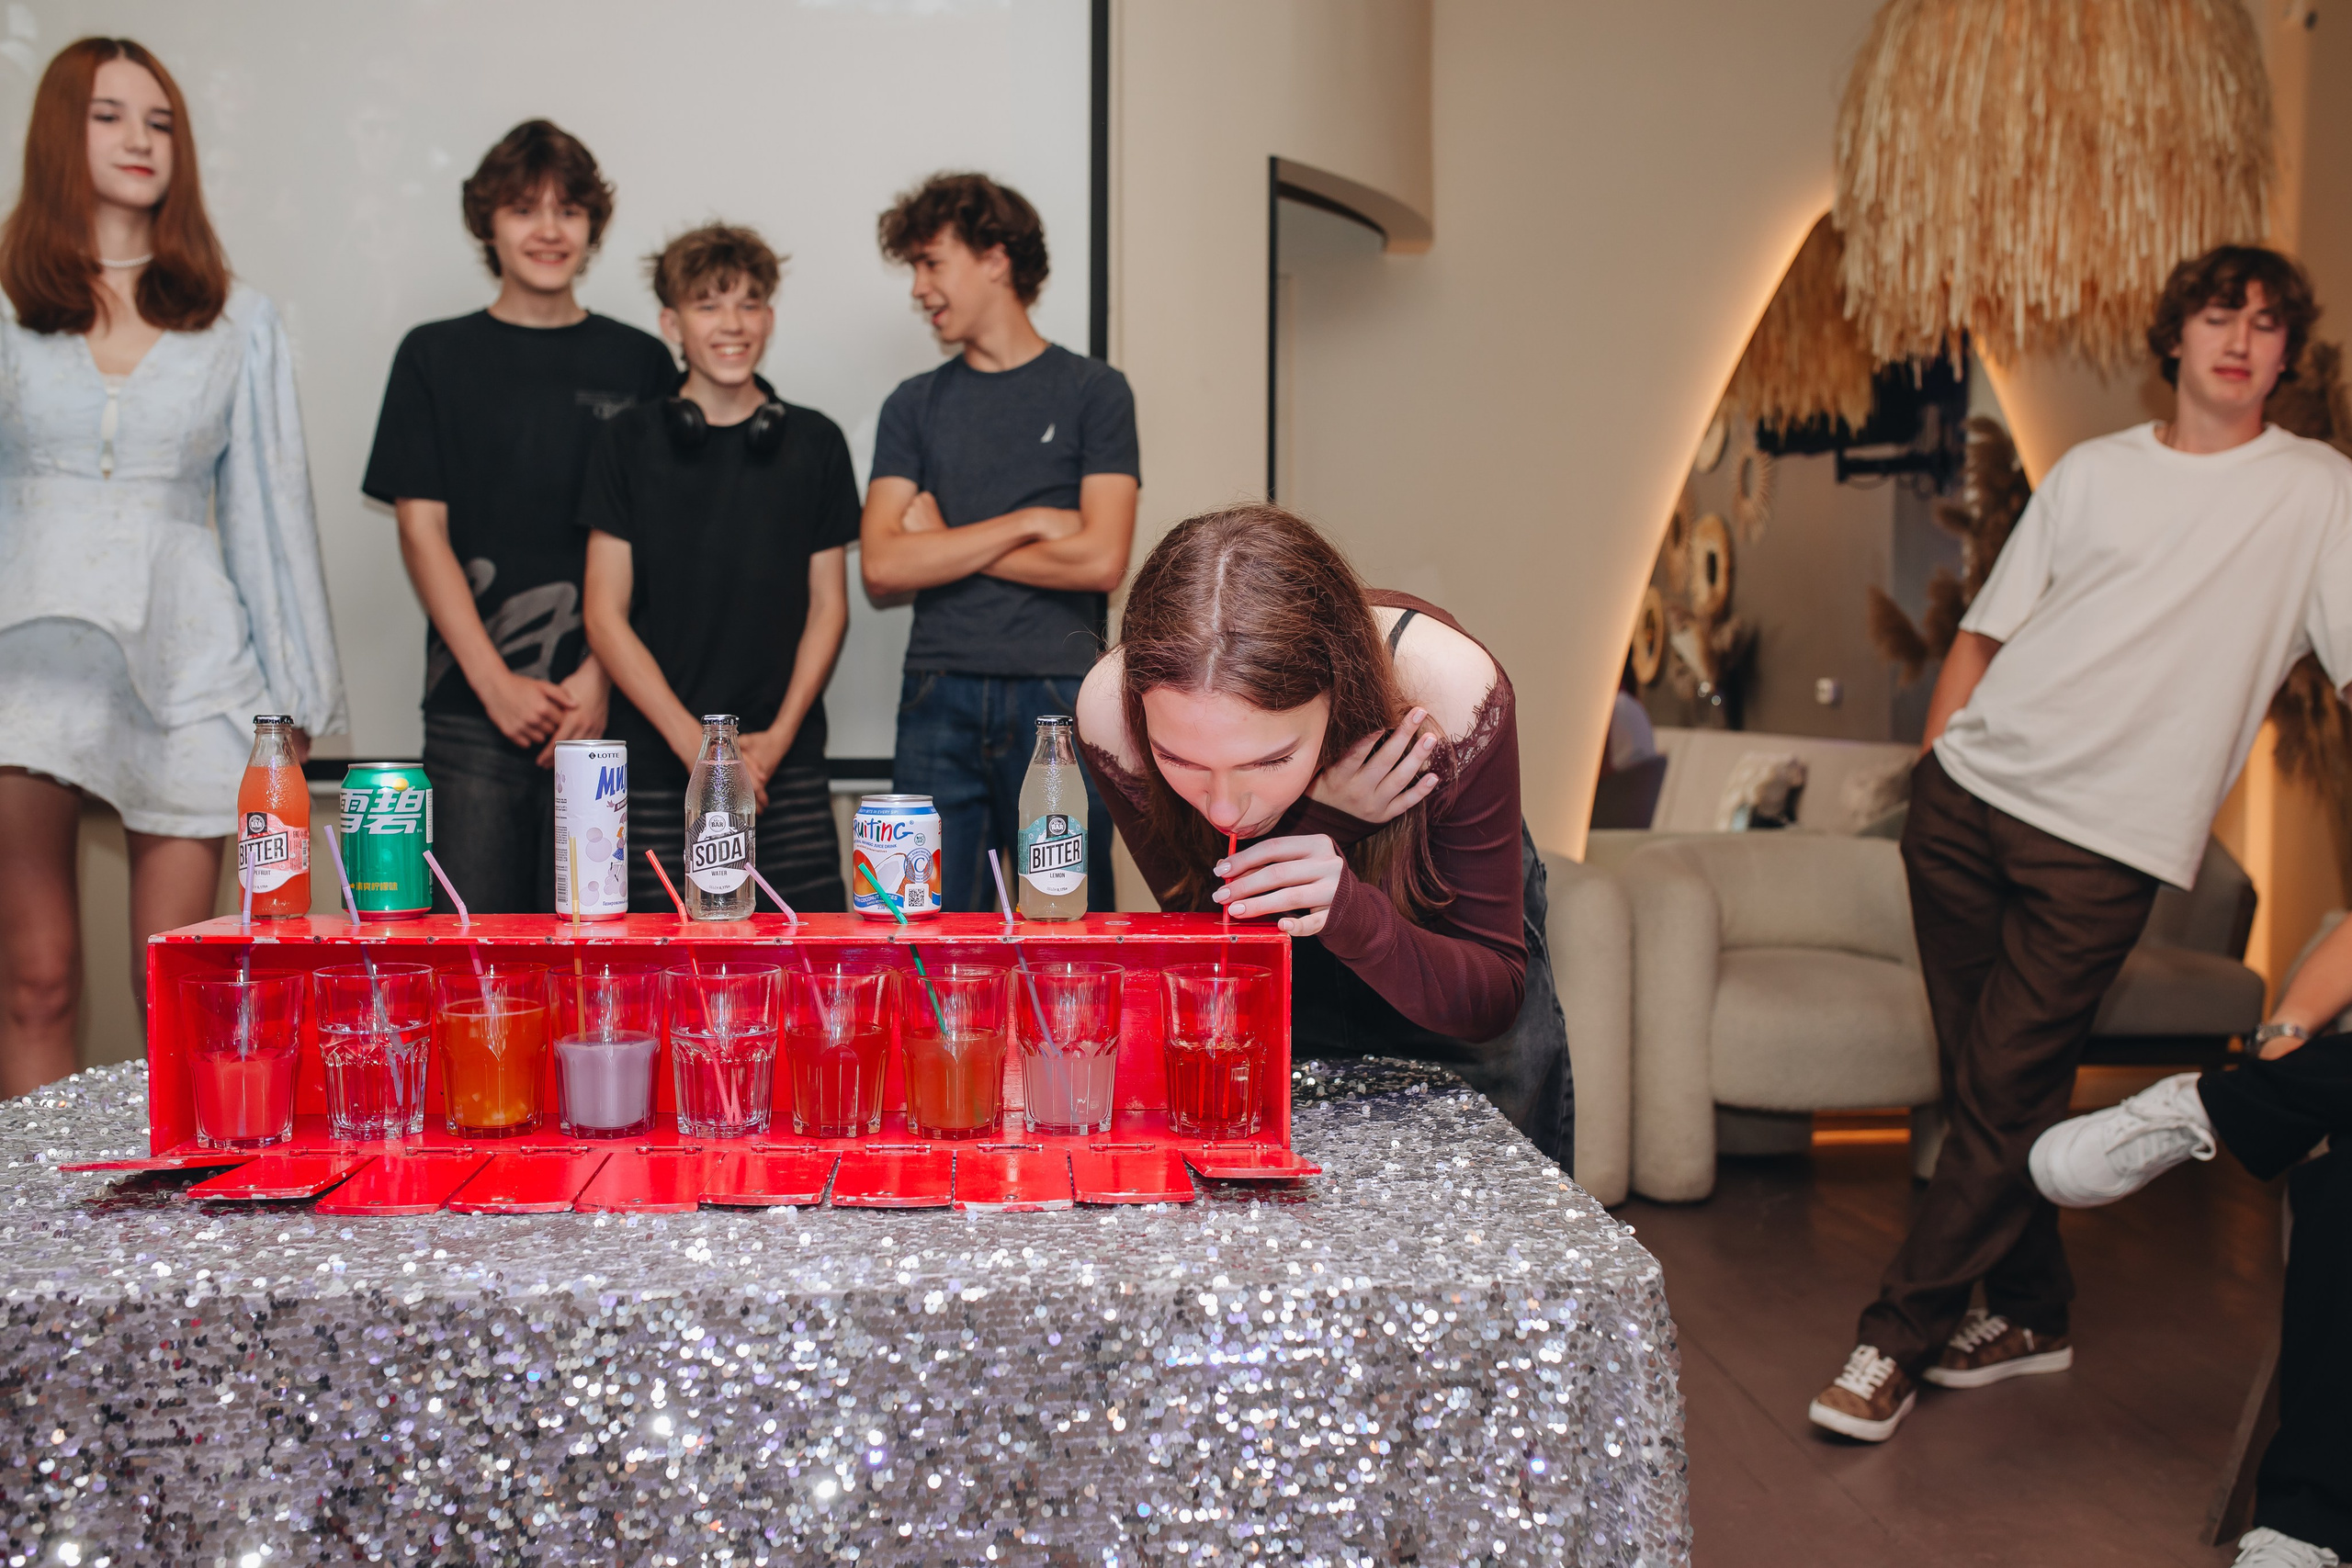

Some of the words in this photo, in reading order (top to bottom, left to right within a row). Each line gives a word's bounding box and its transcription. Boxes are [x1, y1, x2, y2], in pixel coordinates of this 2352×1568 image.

[340, 787, 424, 834] 雪碧
[695, 837, 742, 867] SODA
[914, 857, 925, 873] C
[1033, 839, 1080, 869] BITTER
[861, 895, 879, 903] COCONUT
